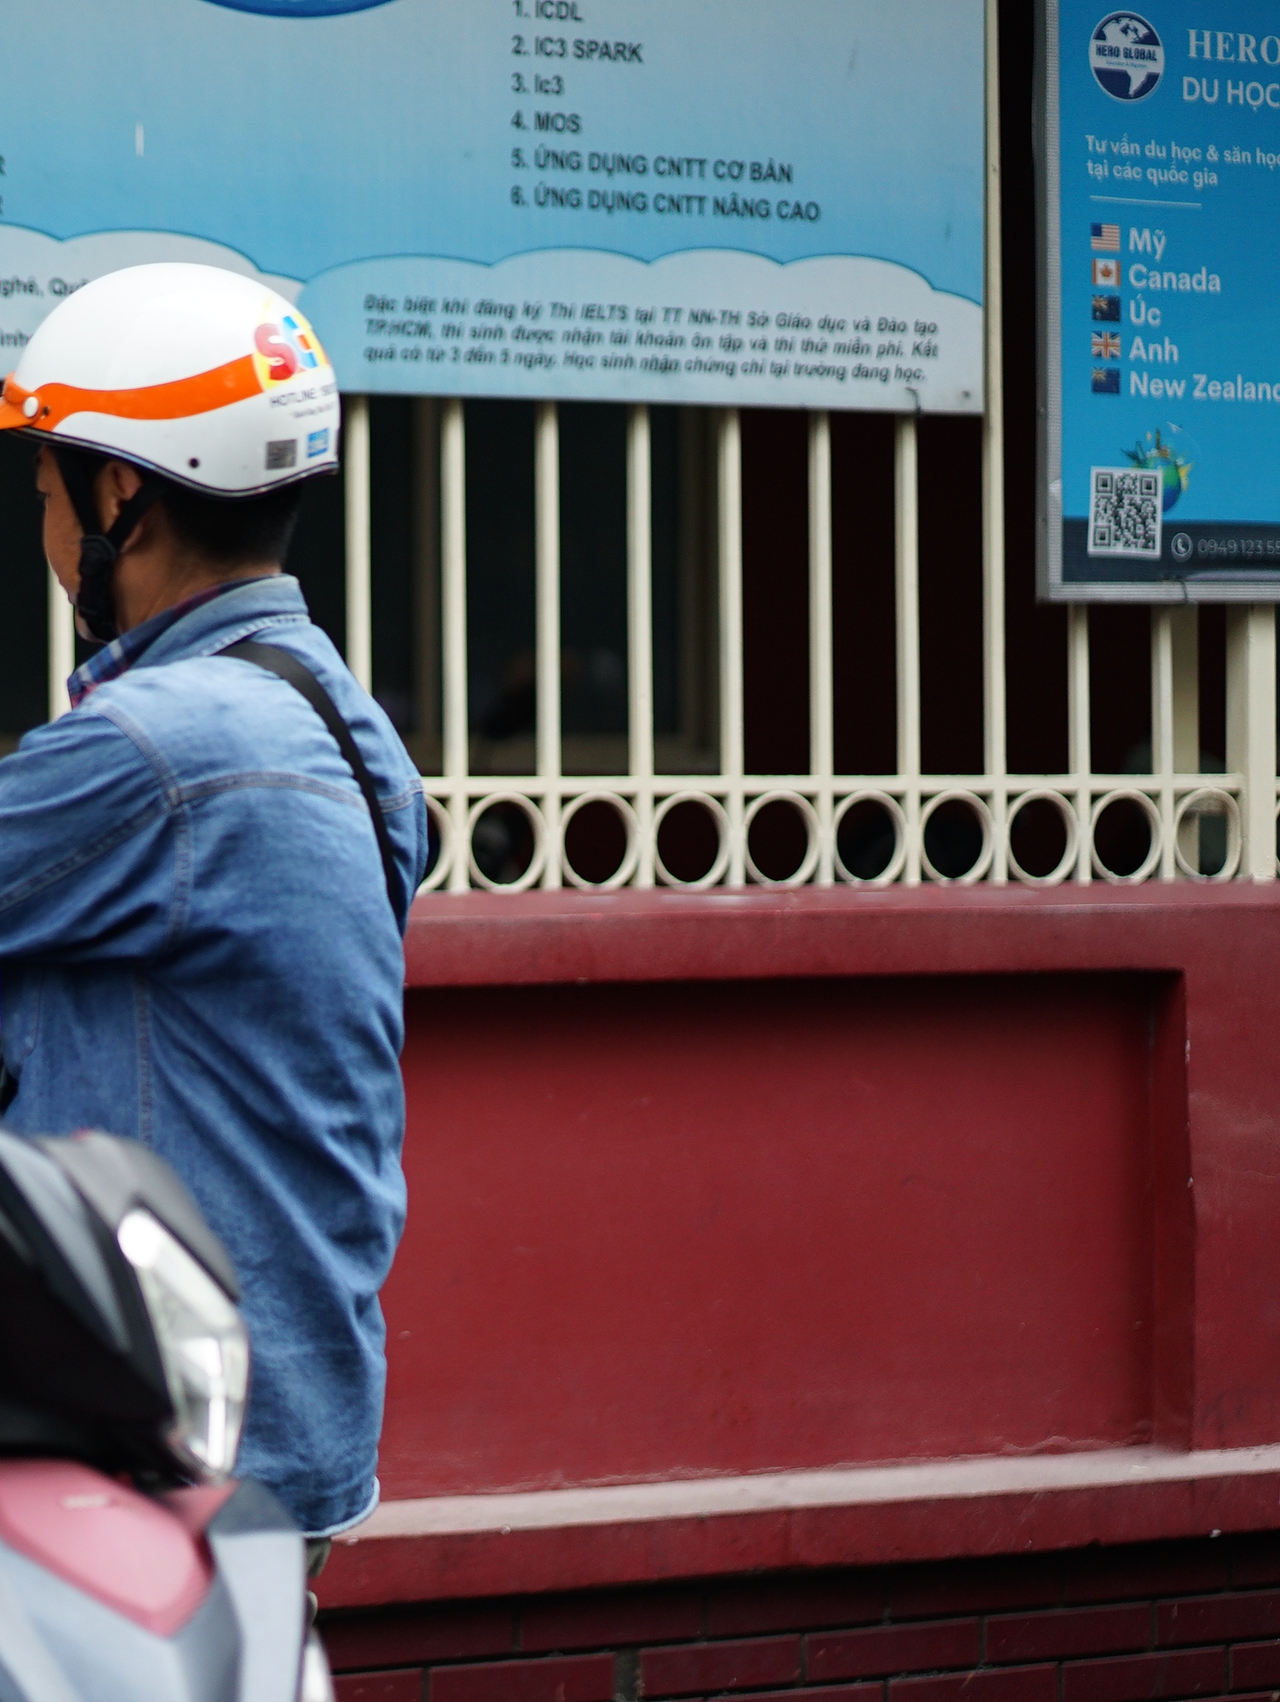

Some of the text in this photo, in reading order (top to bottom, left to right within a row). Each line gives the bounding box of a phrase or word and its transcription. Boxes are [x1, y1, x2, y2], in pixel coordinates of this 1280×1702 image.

[535, 0, 583, 22] ICDL
[511, 34, 643, 63] 2. IC3 SPARK
[1096, 43, 1158, 61] HERO GLOBAL
[1186, 28, 1280, 65] HERO
[511, 71, 529, 94] 3.
[1182, 76, 1280, 112] DU HỌC
[510, 109, 582, 135] 4. MOS
[511, 148, 528, 169] 5.
[535, 143, 581, 172] ỨNG
[587, 151, 648, 178] DỤNG
[653, 155, 707, 180] CNTT
[713, 158, 743, 180] CƠ
[1085, 134, 1107, 153] Tư
[1110, 132, 1140, 156] vấn
[1145, 140, 1168, 159] du
[1171, 141, 1202, 166] học
[1206, 145, 1219, 161] &
[1223, 145, 1252, 165] săn
[1087, 159, 1218, 190] tại các quốc gia
[510, 185, 528, 207] 6.
[535, 181, 581, 209] ỨNG
[587, 188, 648, 215] DỤNG
[653, 191, 707, 216] CNTT
[776, 199, 820, 222] CAO
[1129, 227, 1167, 261] Mỹ
[1128, 263, 1221, 292] Canada
[581, 303, 629, 321] IELTS
[662, 306, 683, 323] TT
[1129, 294, 1162, 326] Úc
[1128, 336, 1179, 363] Anh
[1129, 371, 1186, 398] New
